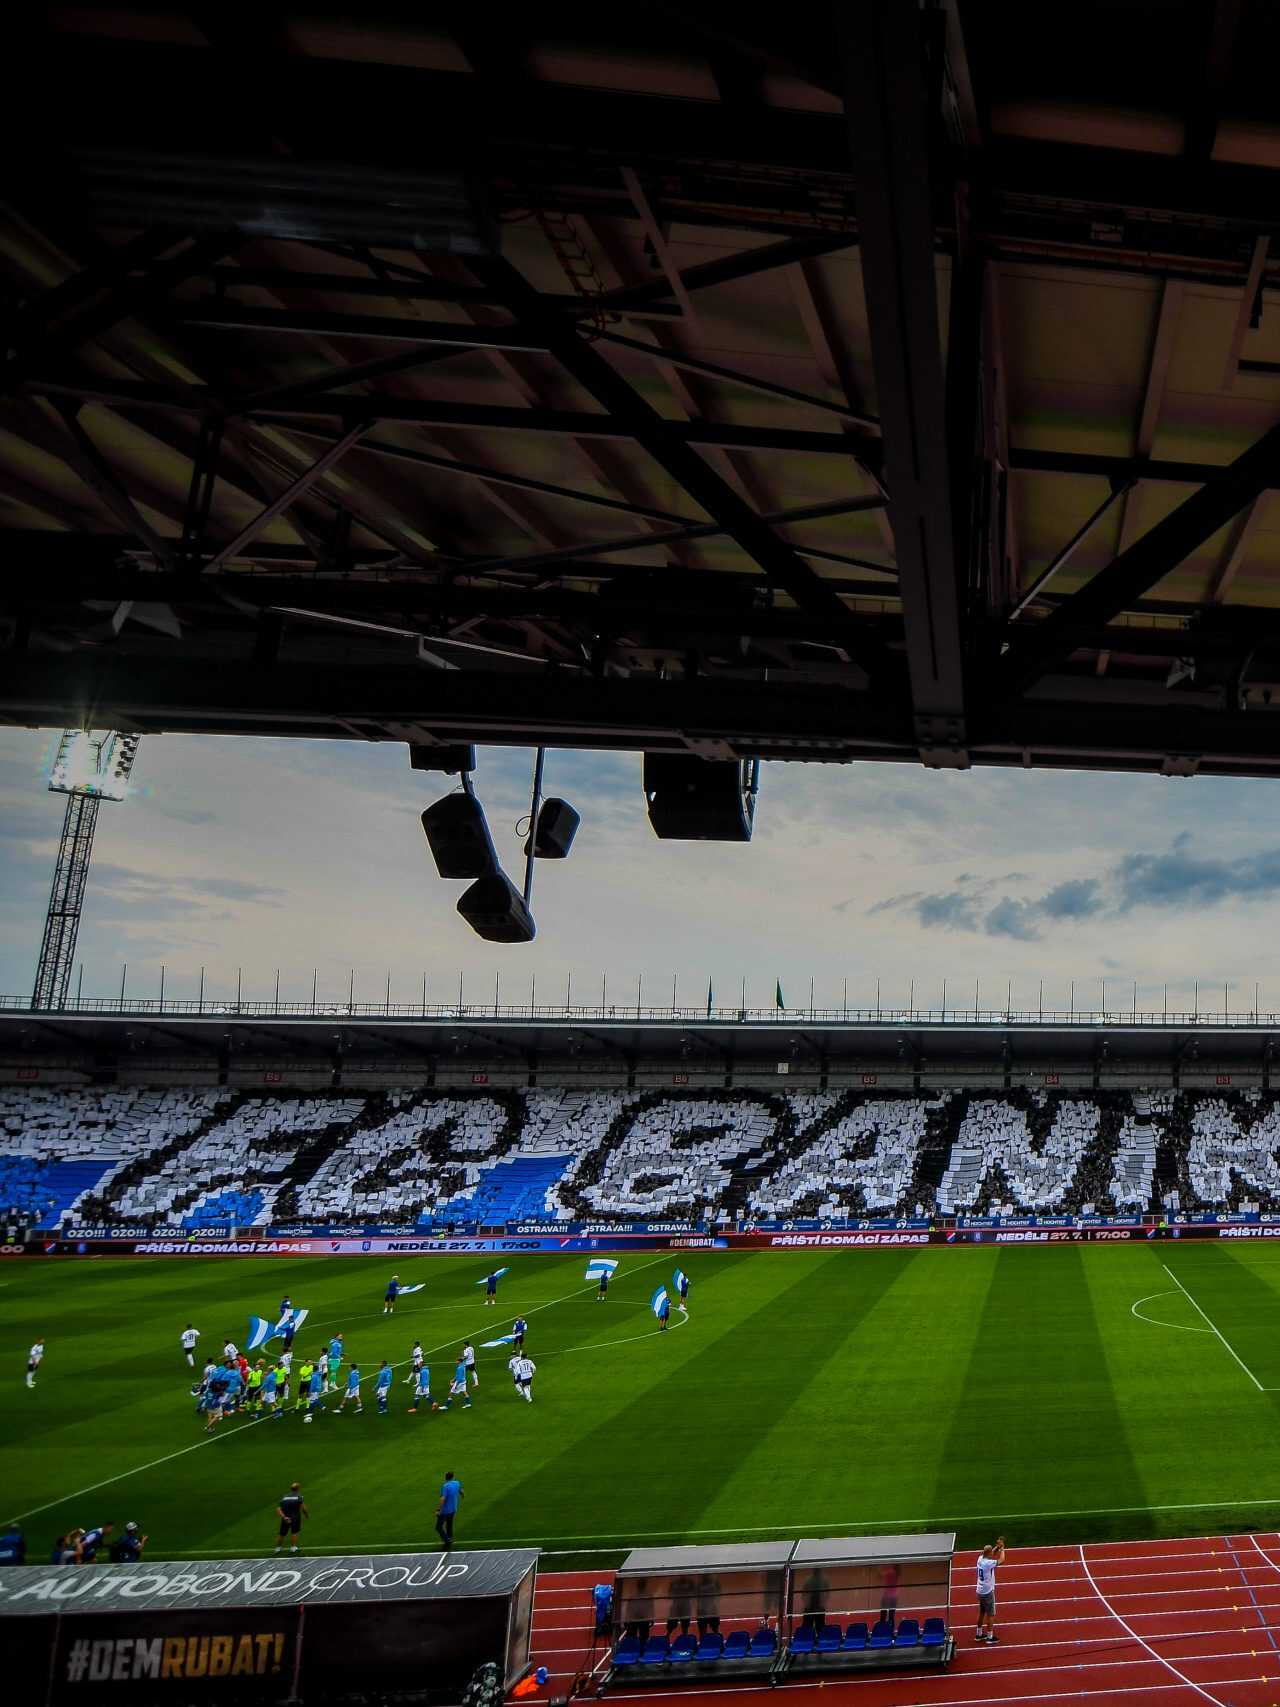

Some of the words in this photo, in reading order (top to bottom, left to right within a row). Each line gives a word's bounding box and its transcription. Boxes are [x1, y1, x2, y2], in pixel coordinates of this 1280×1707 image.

[67, 1229, 105, 1238] OZO!!!
[111, 1229, 147, 1237] OZO!!!
[517, 1225, 568, 1233] OSTRAVA!!!
[1219, 1226, 1263, 1237] PŘÍŠTÍ
[771, 1233, 821, 1246] PŘÍŠTÍ
[821, 1233, 880, 1244] DOMÁCÍ
[881, 1232, 929, 1243] ZÁPAS
[996, 1231, 1049, 1241] NEDĚLE
[1050, 1231, 1071, 1240] 27.
[1095, 1231, 1131, 1239] 17:00
[134, 1242, 190, 1253] PŘÍŠTÍ
[190, 1241, 255, 1253] DOMÁCÍ
[255, 1240, 312, 1252] ZÁPAS
[387, 1240, 449, 1250] NEDĚLE
[449, 1242, 471, 1250] 27.
[500, 1241, 541, 1249] 17:00
[14, 1570, 302, 1600] AUTOBOND
[308, 1564, 470, 1591] GROUP
[67, 1632, 287, 1682] #DEMRUBAT!
